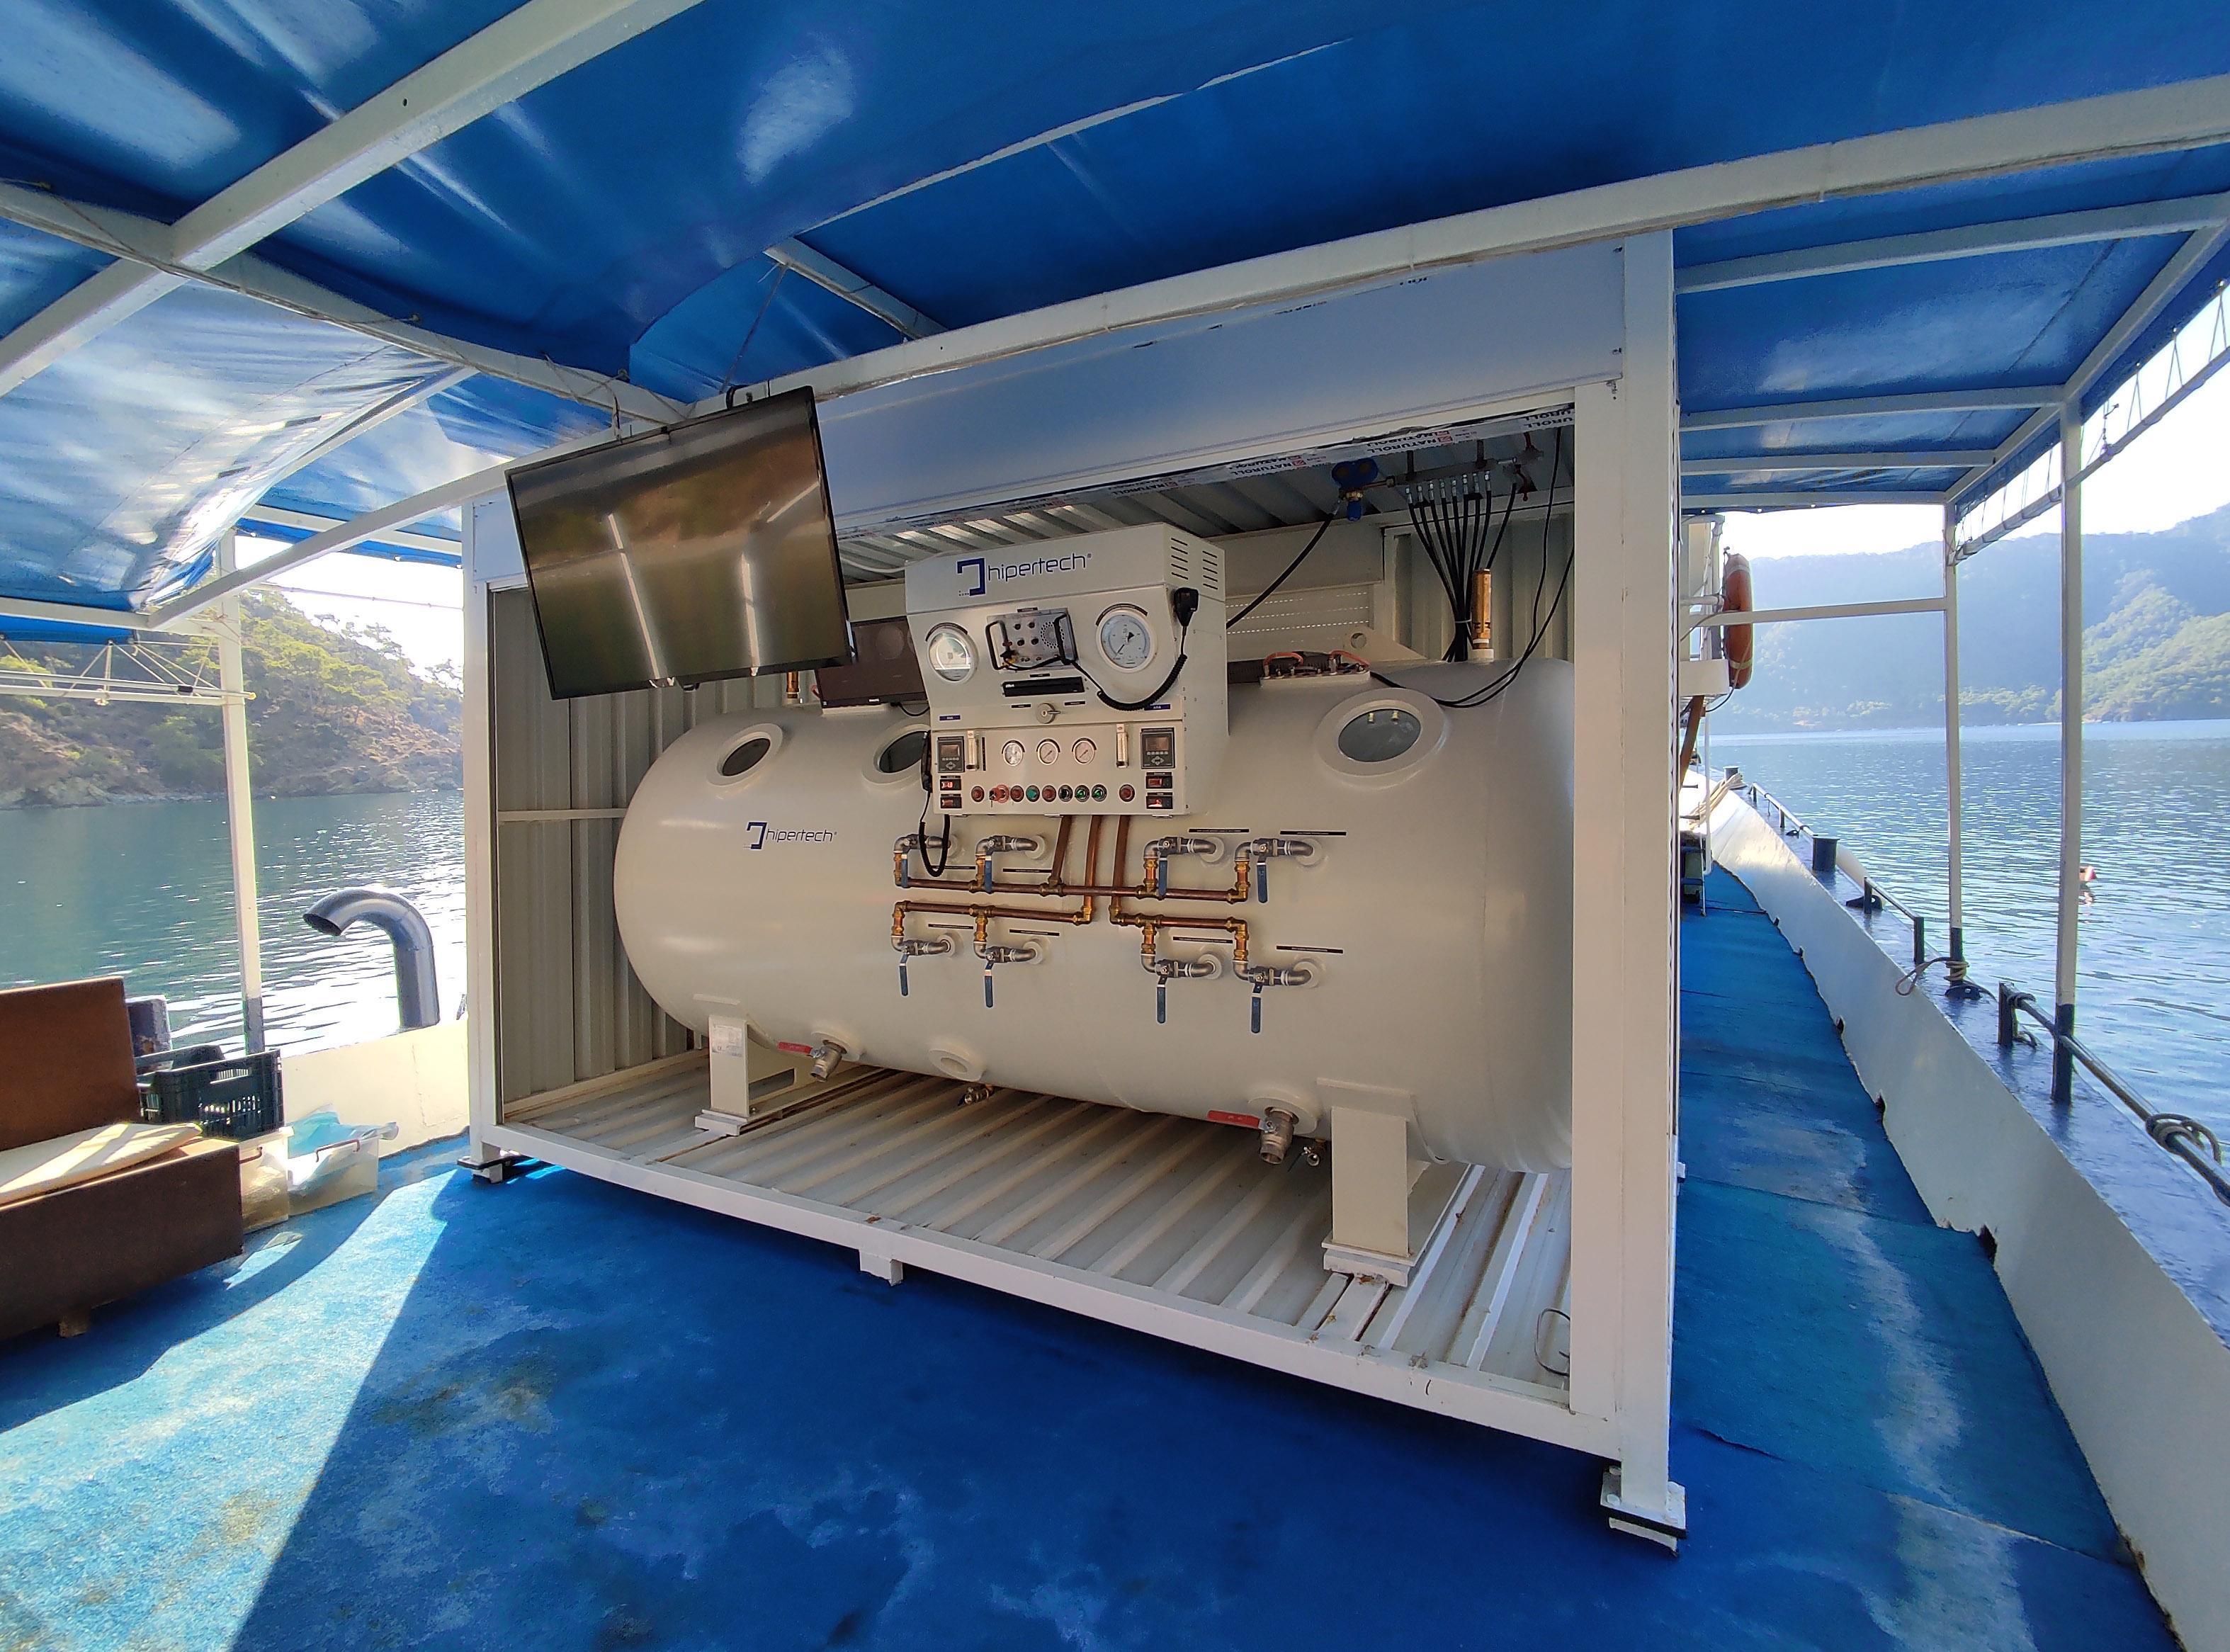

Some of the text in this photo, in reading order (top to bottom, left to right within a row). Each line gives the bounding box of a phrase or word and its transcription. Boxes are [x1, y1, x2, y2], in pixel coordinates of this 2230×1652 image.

[1367, 438, 1437, 453] NATUROLL
[1231, 462, 1292, 475] NATUROLL
[987, 553, 1086, 582] hipertech
[765, 828, 834, 843] hipertech
